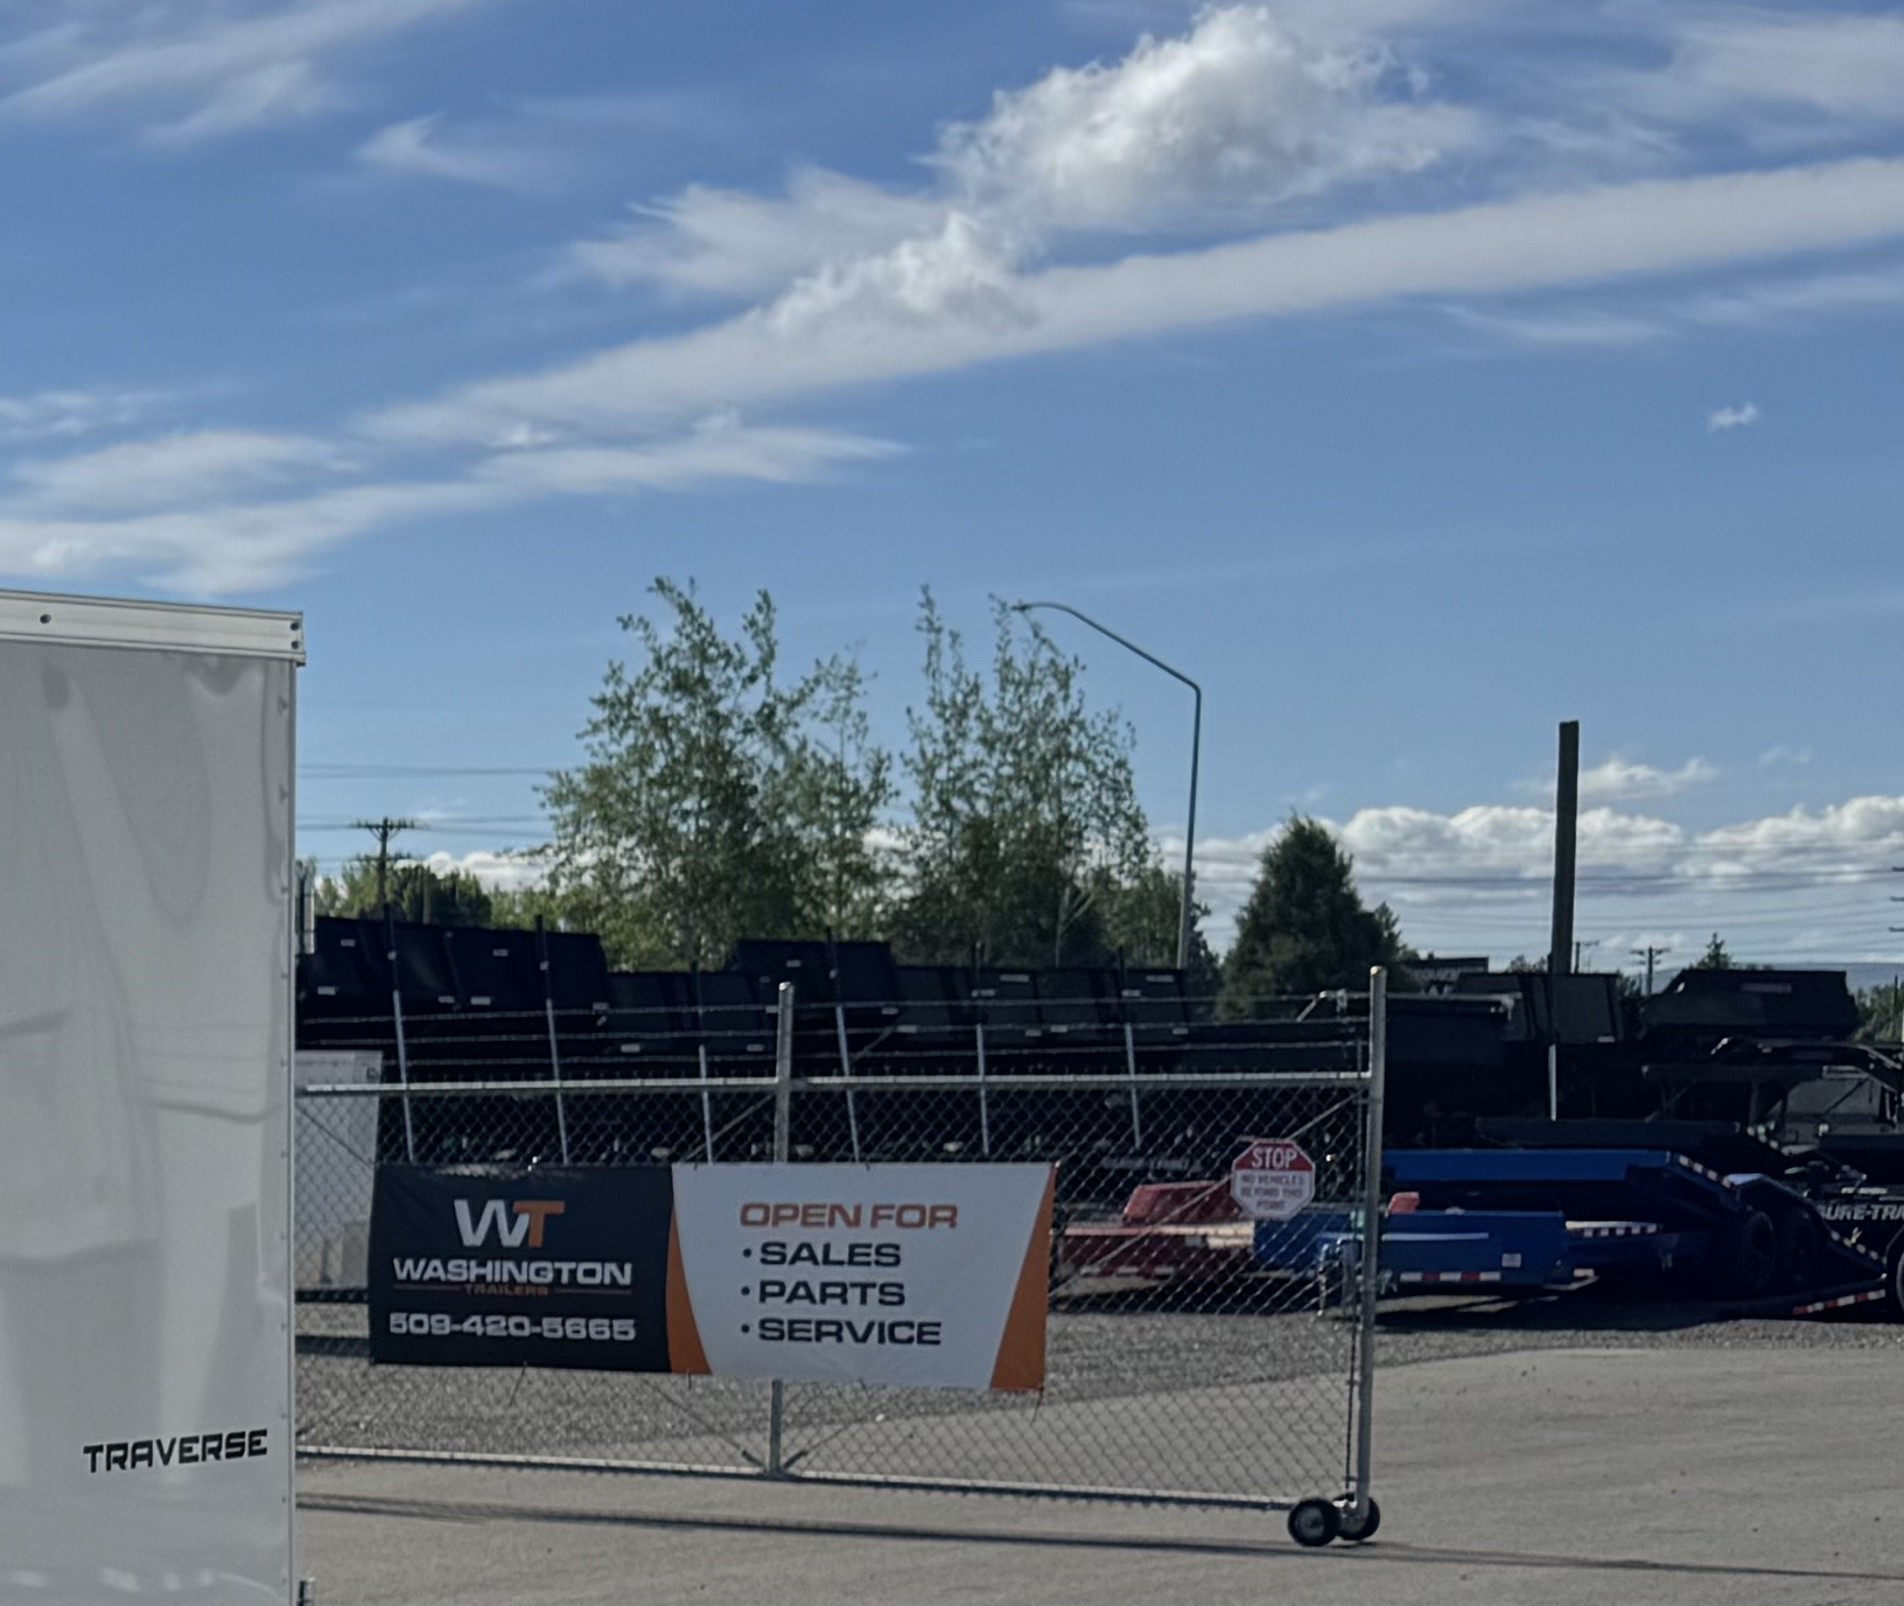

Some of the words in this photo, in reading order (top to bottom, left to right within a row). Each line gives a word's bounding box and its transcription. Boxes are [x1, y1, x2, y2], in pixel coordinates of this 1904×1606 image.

[1251, 1147, 1297, 1168] STOP
[1241, 1174, 1254, 1184] NO
[1258, 1174, 1304, 1184] VEHICLES
[454, 1199, 566, 1248] WT
[740, 1203, 862, 1229] OPEN
[869, 1204, 958, 1229] FOR
[759, 1241, 902, 1267] SALES
[393, 1257, 633, 1286] WASHINGTON
[463, 1284, 550, 1296] TRAILERS
[759, 1280, 906, 1306] PARTS
[389, 1312, 637, 1341] 509-420-5665
[758, 1317, 943, 1345] SERVICE
[82, 1428, 268, 1473] TRAVERSE
